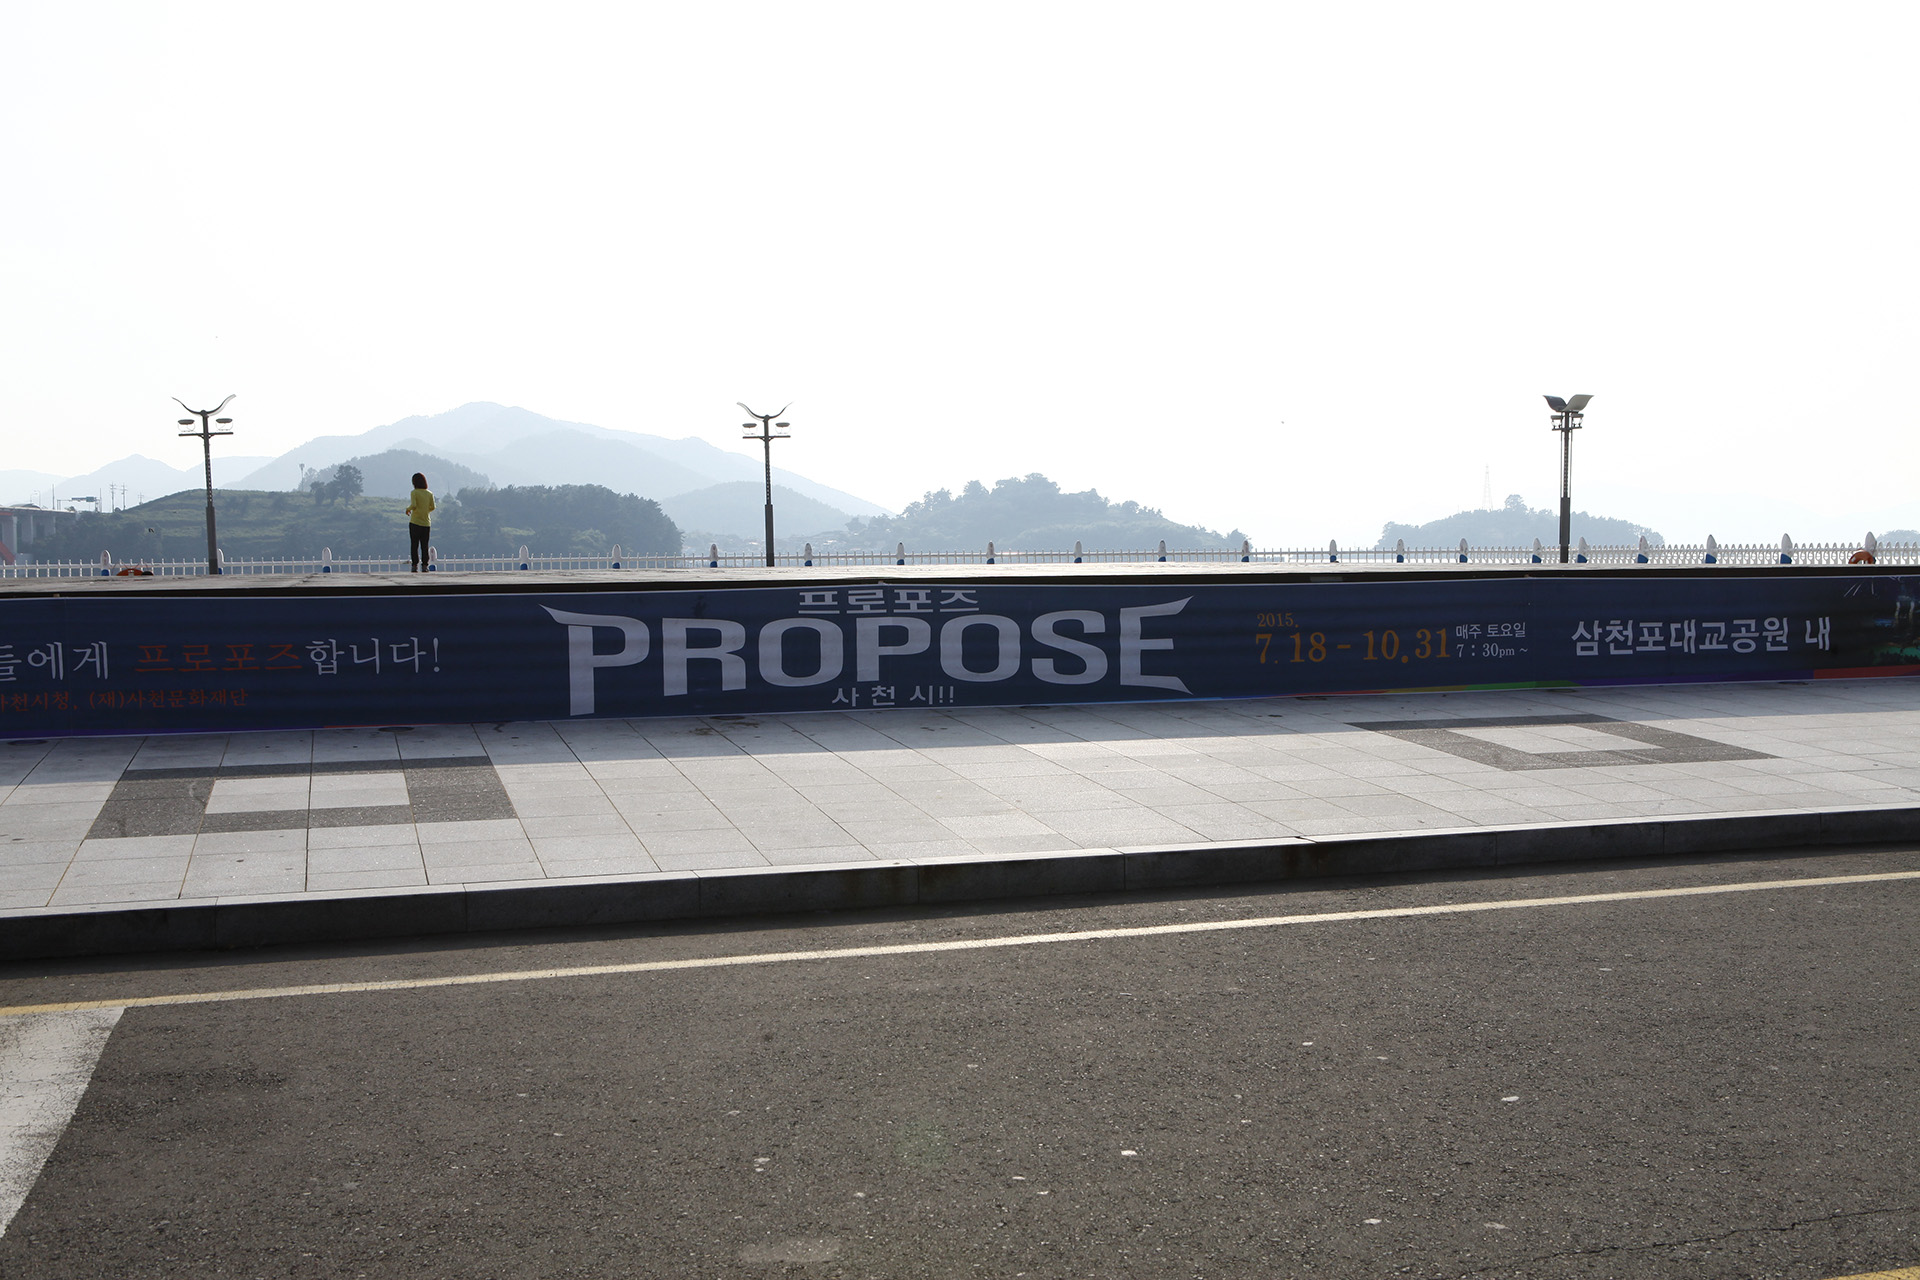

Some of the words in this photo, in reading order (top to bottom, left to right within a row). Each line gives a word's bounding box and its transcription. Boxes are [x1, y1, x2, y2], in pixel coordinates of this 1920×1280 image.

[798, 589, 980, 614] 프로포즈
[1362, 628, 1451, 664] 10.31
[1455, 623, 1483, 640] 매주
[1486, 622, 1527, 638] 토요일
[1570, 616, 1790, 657] 삼천포대교공원
[1804, 616, 1831, 651] 내
[540, 596, 1194, 716] PROPOSE
